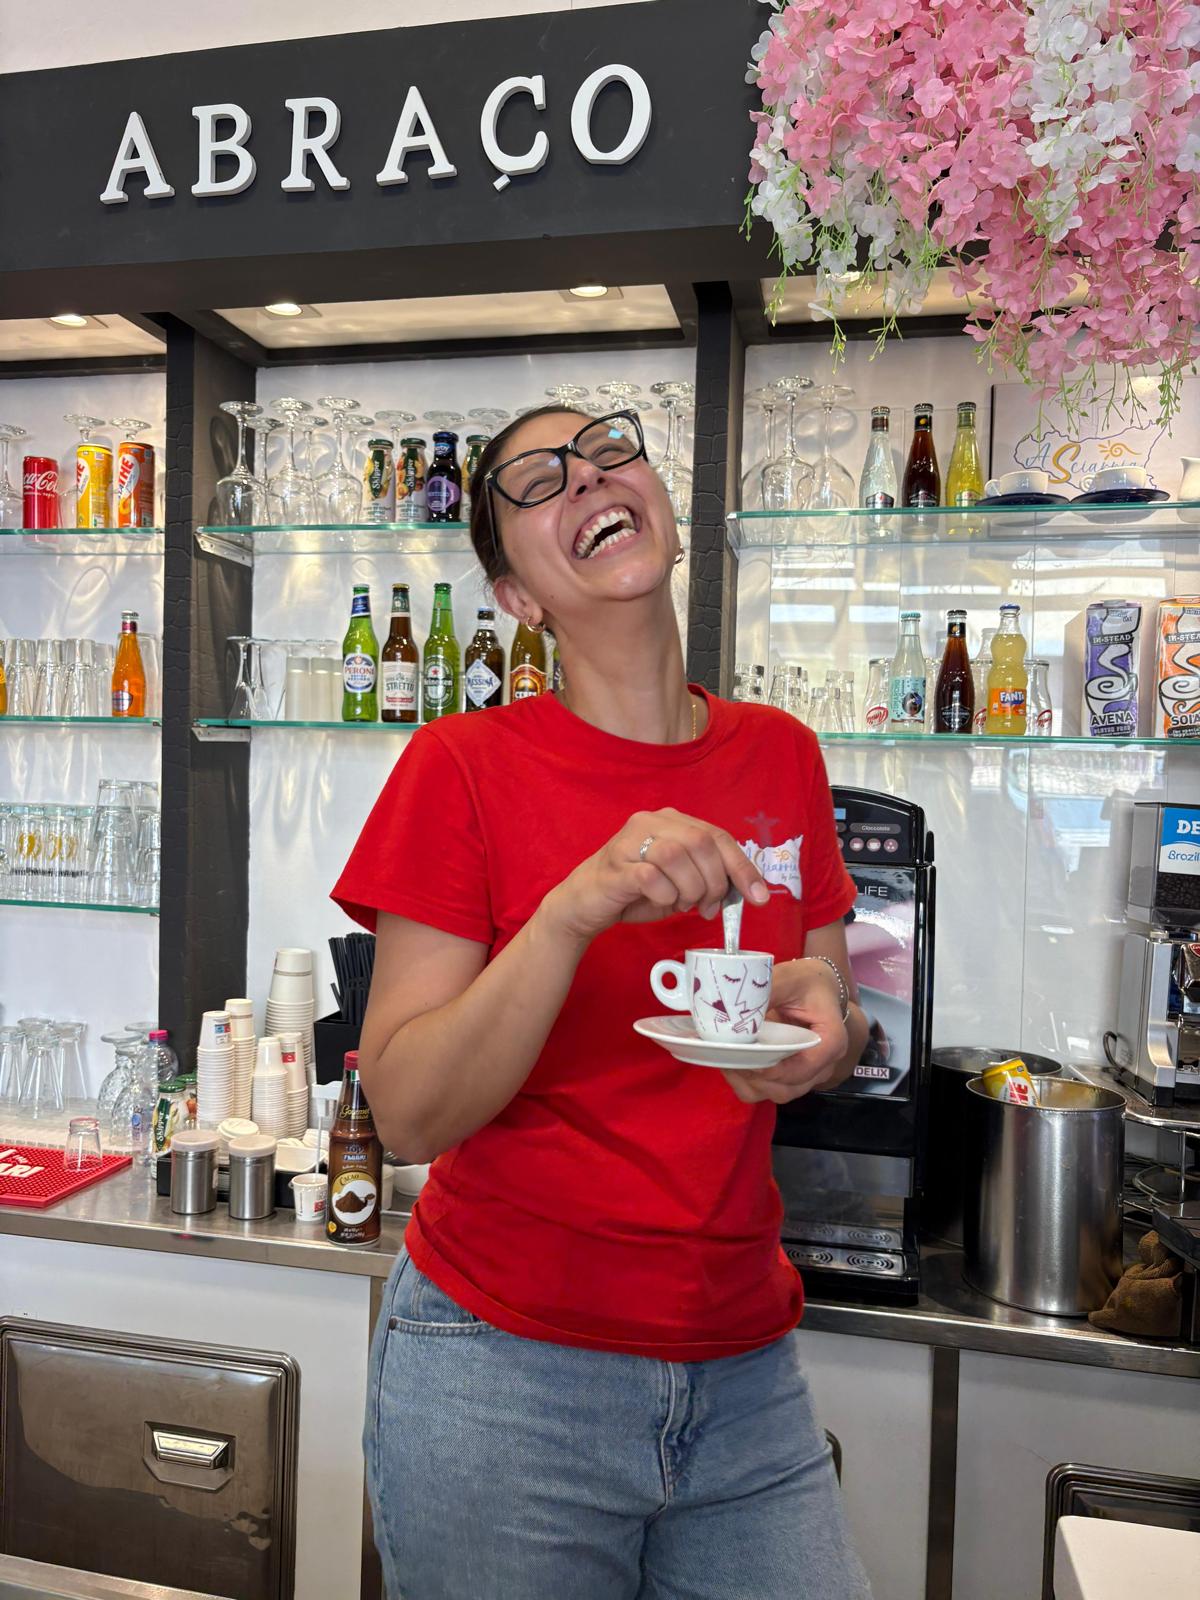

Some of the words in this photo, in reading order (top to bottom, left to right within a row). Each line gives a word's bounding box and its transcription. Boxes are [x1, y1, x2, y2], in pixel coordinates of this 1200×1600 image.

[100, 64, 652, 203] ABRAÇO
[371, 460, 381, 489] Skipper
[406, 459, 415, 488] Skipper
[386, 681, 414, 692] STRETTO
[1091, 712, 1134, 726] AVENA
[856, 1066, 888, 1078] DELIX
